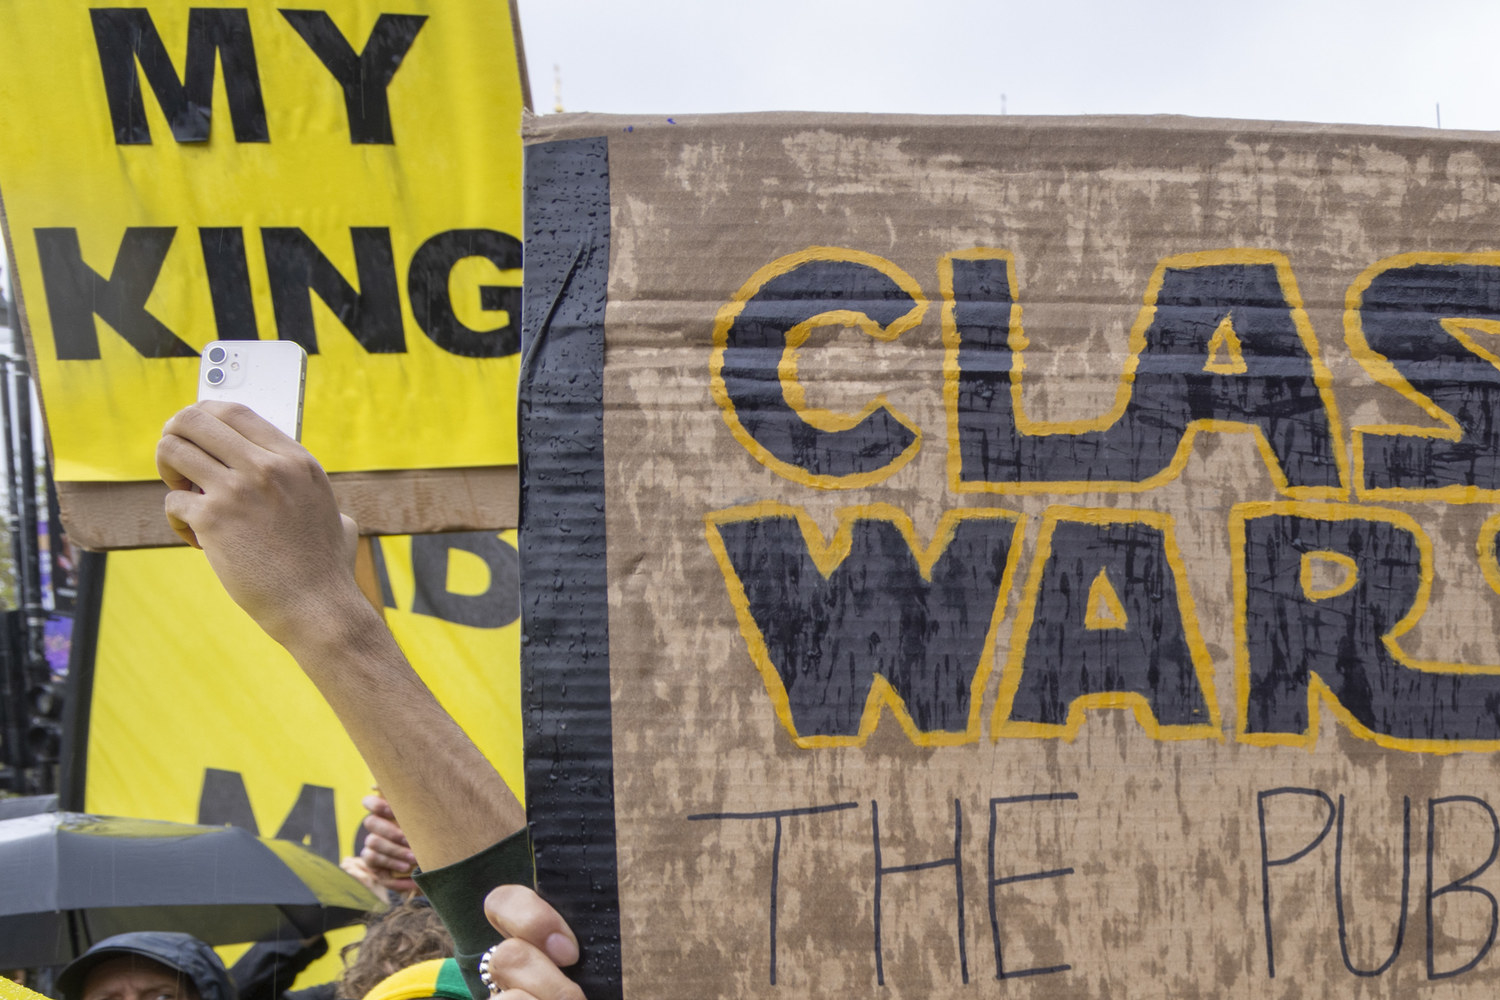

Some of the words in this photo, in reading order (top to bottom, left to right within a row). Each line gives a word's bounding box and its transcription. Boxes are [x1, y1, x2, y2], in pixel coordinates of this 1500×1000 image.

[89, 7, 429, 145] MY
[33, 225, 523, 360] KING
[688, 792, 1079, 986] THE
